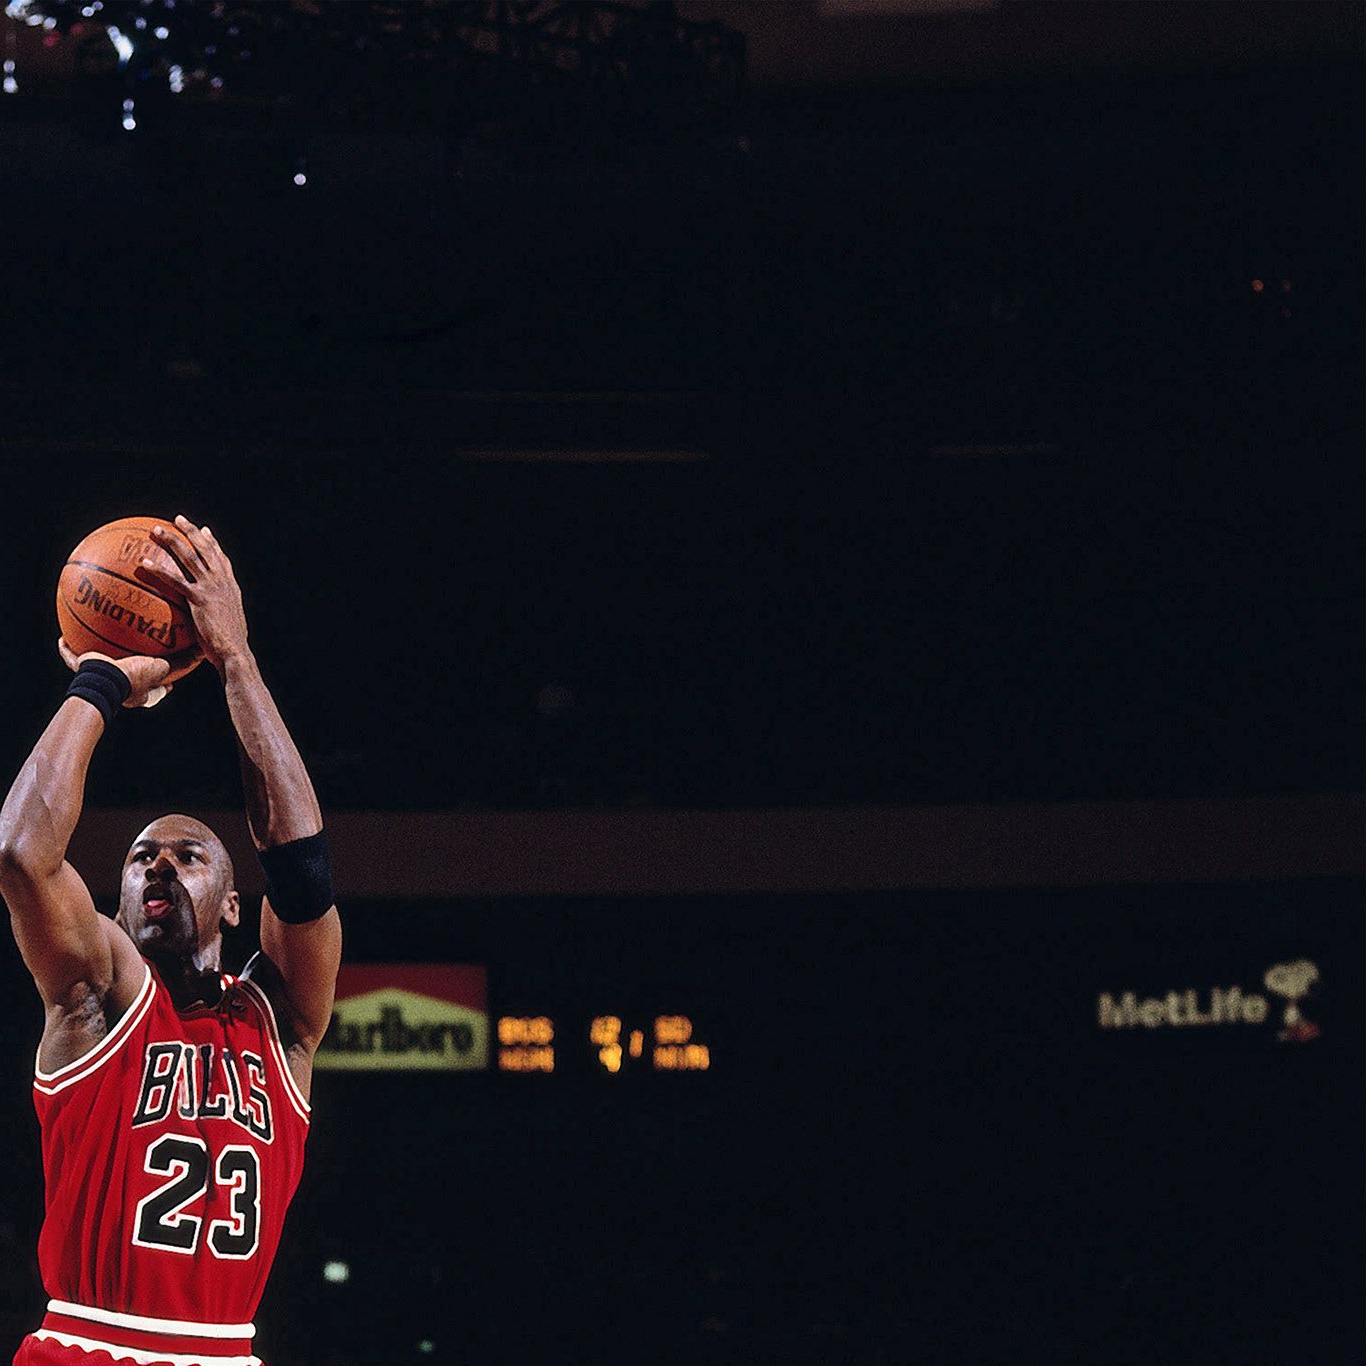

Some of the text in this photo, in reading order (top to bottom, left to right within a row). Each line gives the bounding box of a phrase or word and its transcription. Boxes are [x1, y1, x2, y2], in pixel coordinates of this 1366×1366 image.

[74, 575, 182, 649] SPALDING
[322, 1002, 475, 1056] arlboro
[132, 1040, 274, 1145] BULLS
[132, 1133, 261, 1260] 23
